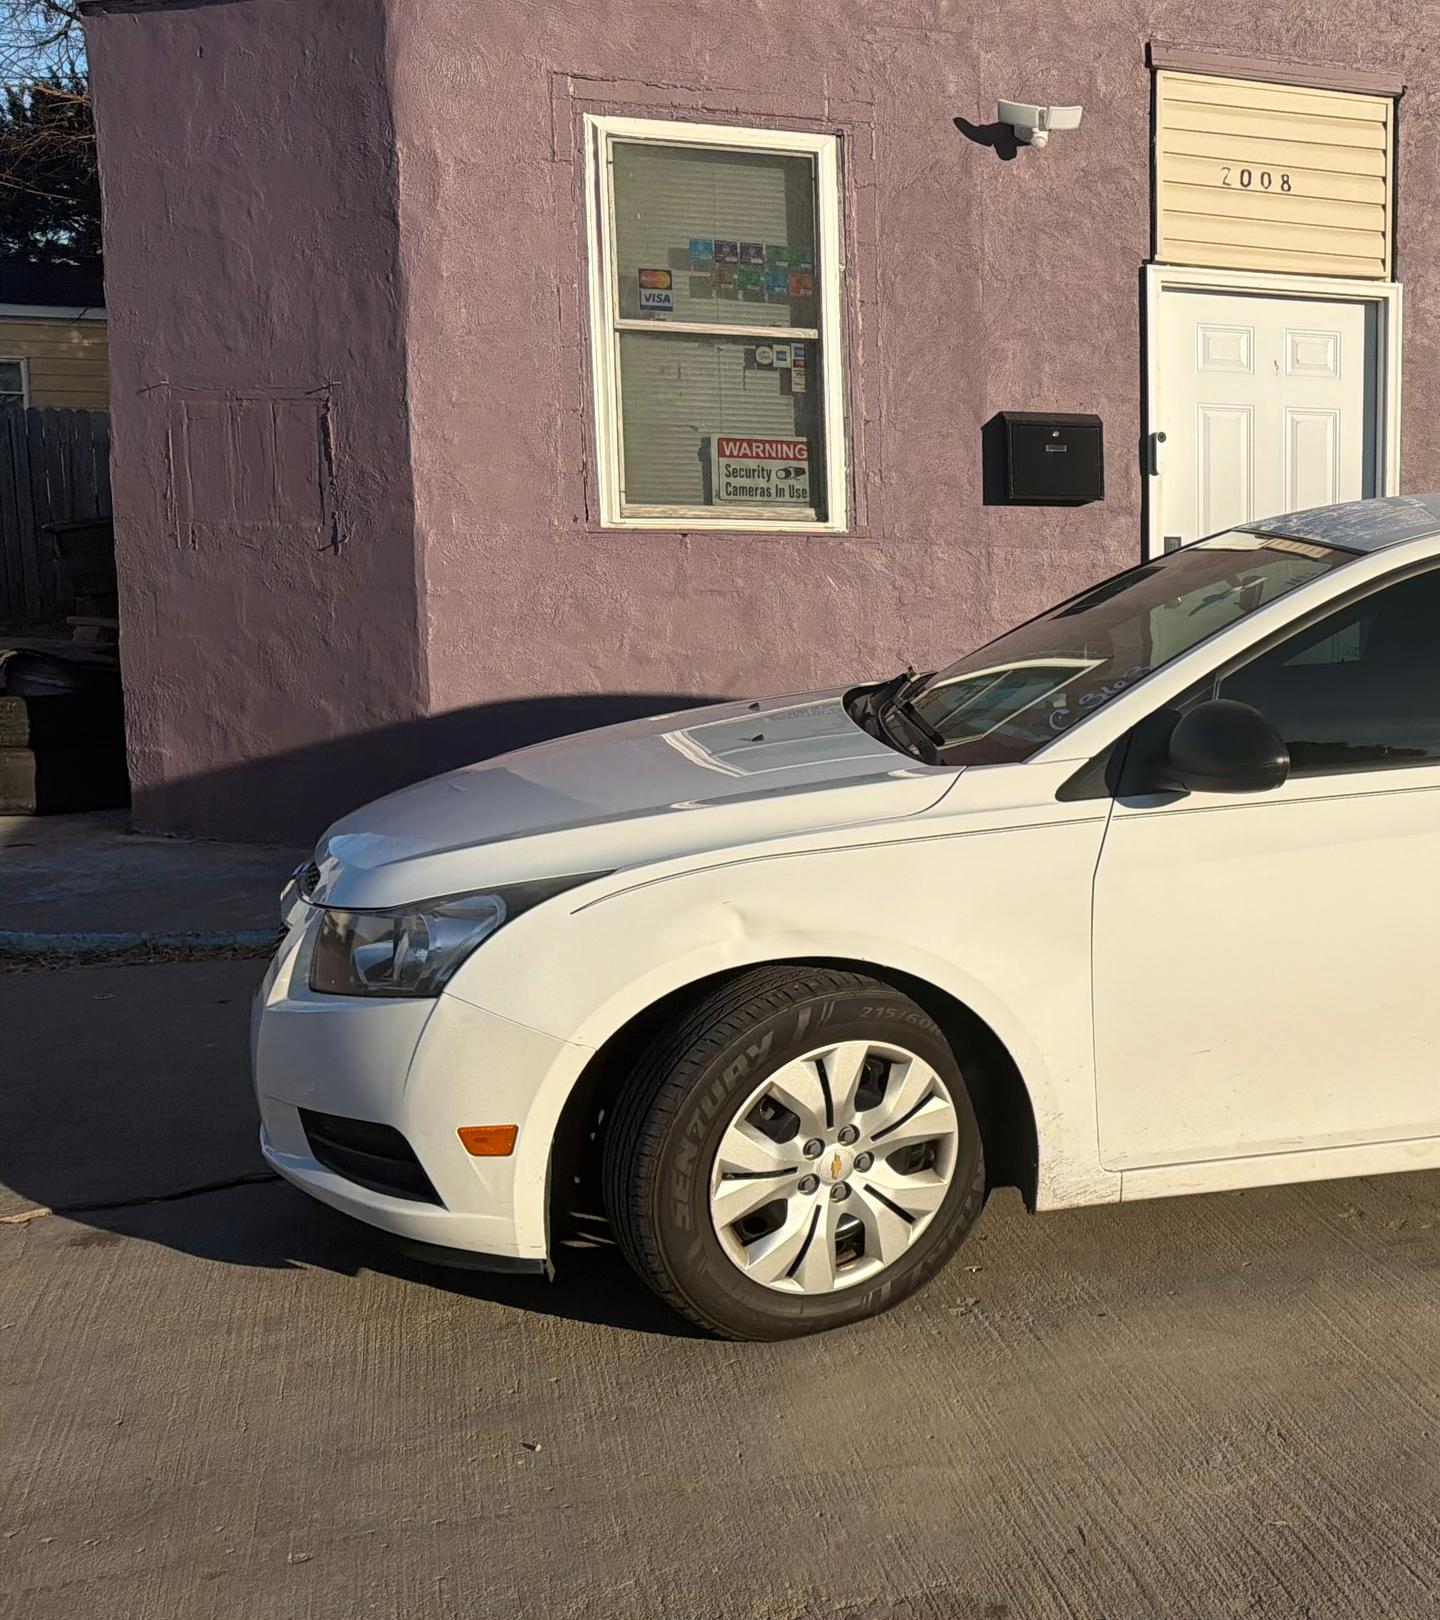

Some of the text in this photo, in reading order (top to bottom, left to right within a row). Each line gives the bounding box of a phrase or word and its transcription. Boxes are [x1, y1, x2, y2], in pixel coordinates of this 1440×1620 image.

[1220, 166, 1292, 192] 2008
[643, 293, 671, 305] VISA
[722, 441, 808, 459] WARNING
[725, 463, 772, 482] Security
[725, 481, 808, 499] Cameras In Use
[670, 1028, 775, 1234] SENTURY
